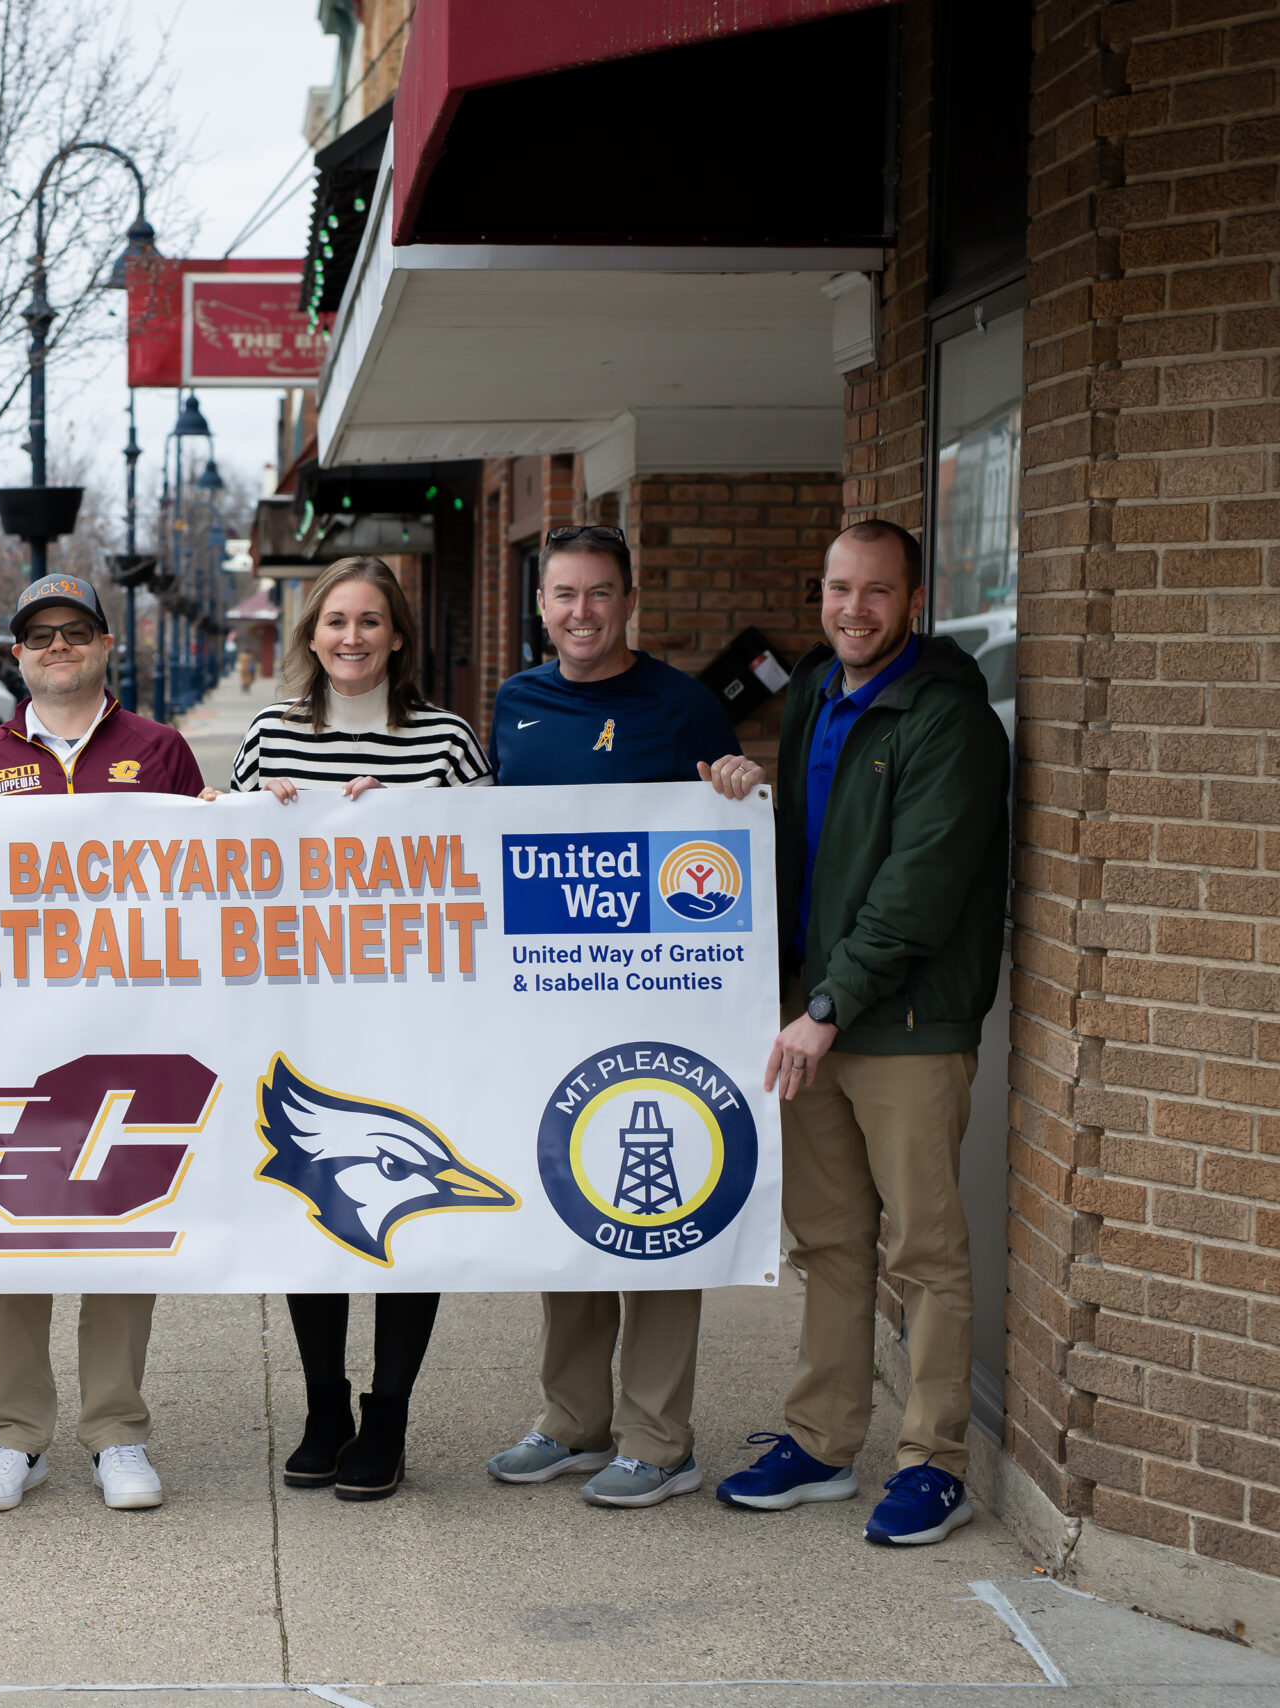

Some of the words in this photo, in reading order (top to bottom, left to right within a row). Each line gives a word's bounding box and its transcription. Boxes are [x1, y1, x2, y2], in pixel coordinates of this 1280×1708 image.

[227, 332, 282, 349] THE
[8, 838, 283, 895] BACKYARD
[298, 834, 479, 893] BRAWL
[508, 842, 642, 880] United
[560, 883, 642, 928] Way
[220, 901, 486, 981] BENEFIT
[512, 944, 583, 965] United
[588, 944, 635, 968] Way
[640, 943, 664, 963] of
[669, 943, 745, 963] Gratiot
[512, 974, 529, 993] &
[535, 972, 620, 992] Isabella
[625, 971, 723, 991] Counties
[555, 1072, 597, 1115] MT.
[596, 1050, 740, 1112] PLEASANT
[595, 1221, 704, 1255] OILERS
